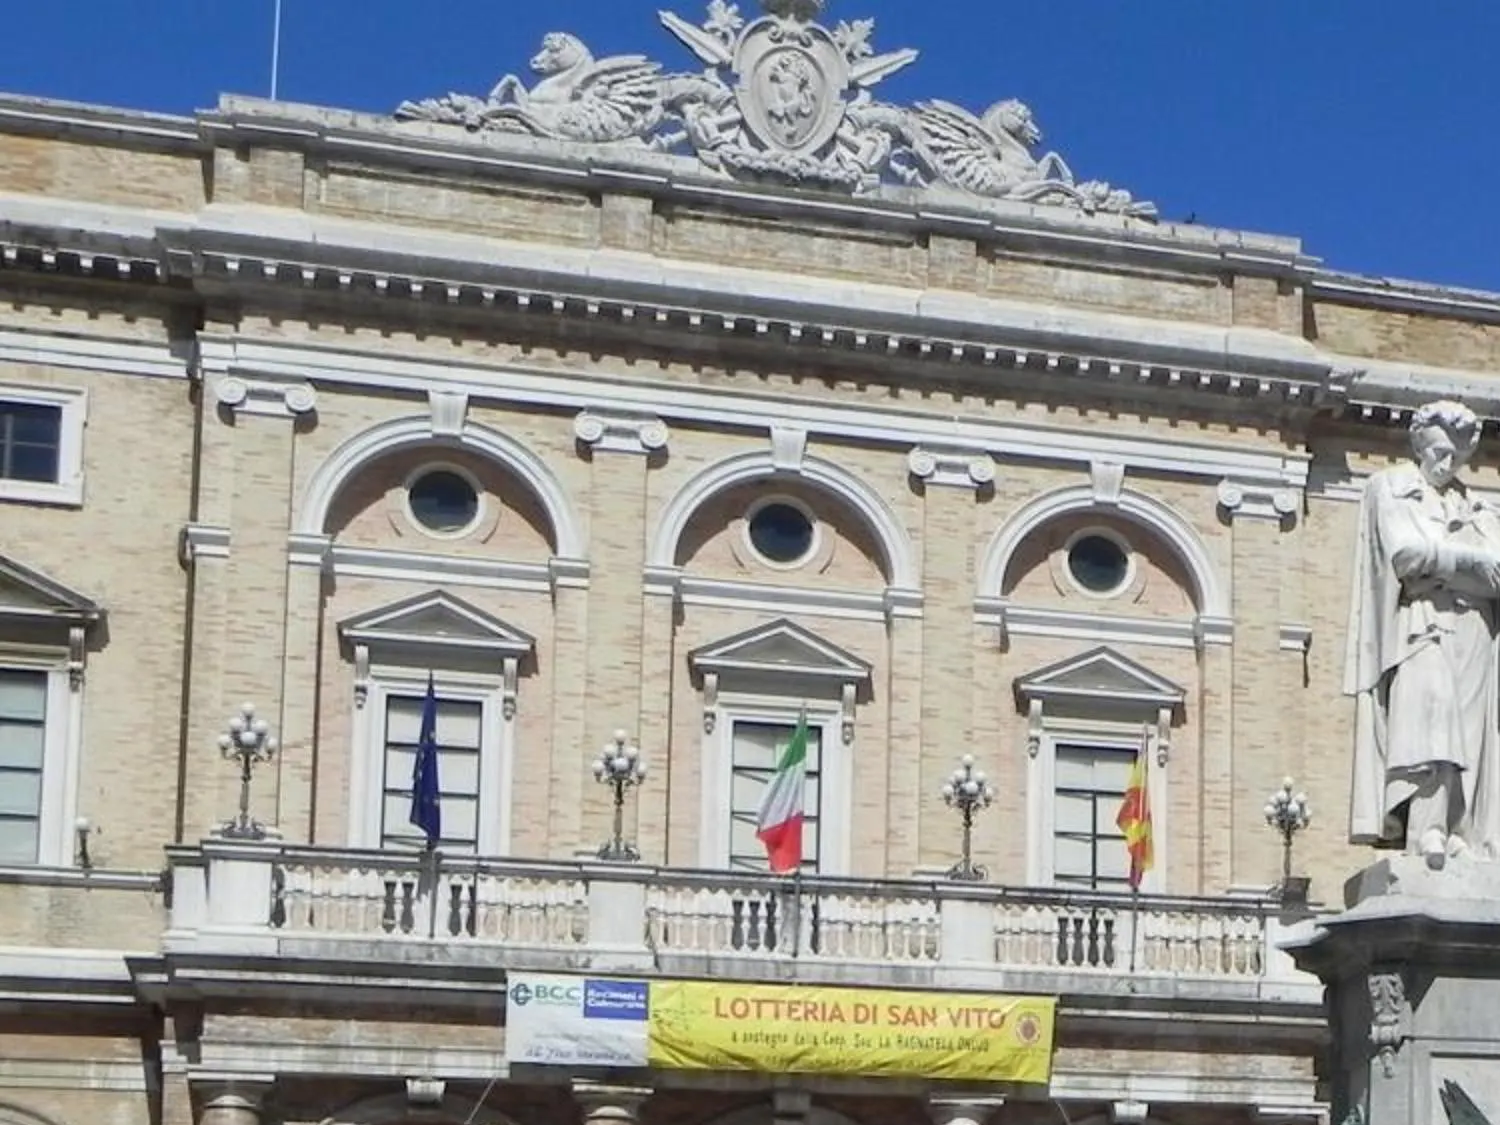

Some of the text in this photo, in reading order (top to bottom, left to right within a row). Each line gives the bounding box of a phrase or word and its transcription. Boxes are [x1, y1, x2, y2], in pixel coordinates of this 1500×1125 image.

[535, 984, 581, 1000] BCC
[715, 996, 1007, 1030] LOTTERIA DI SAN VITO
